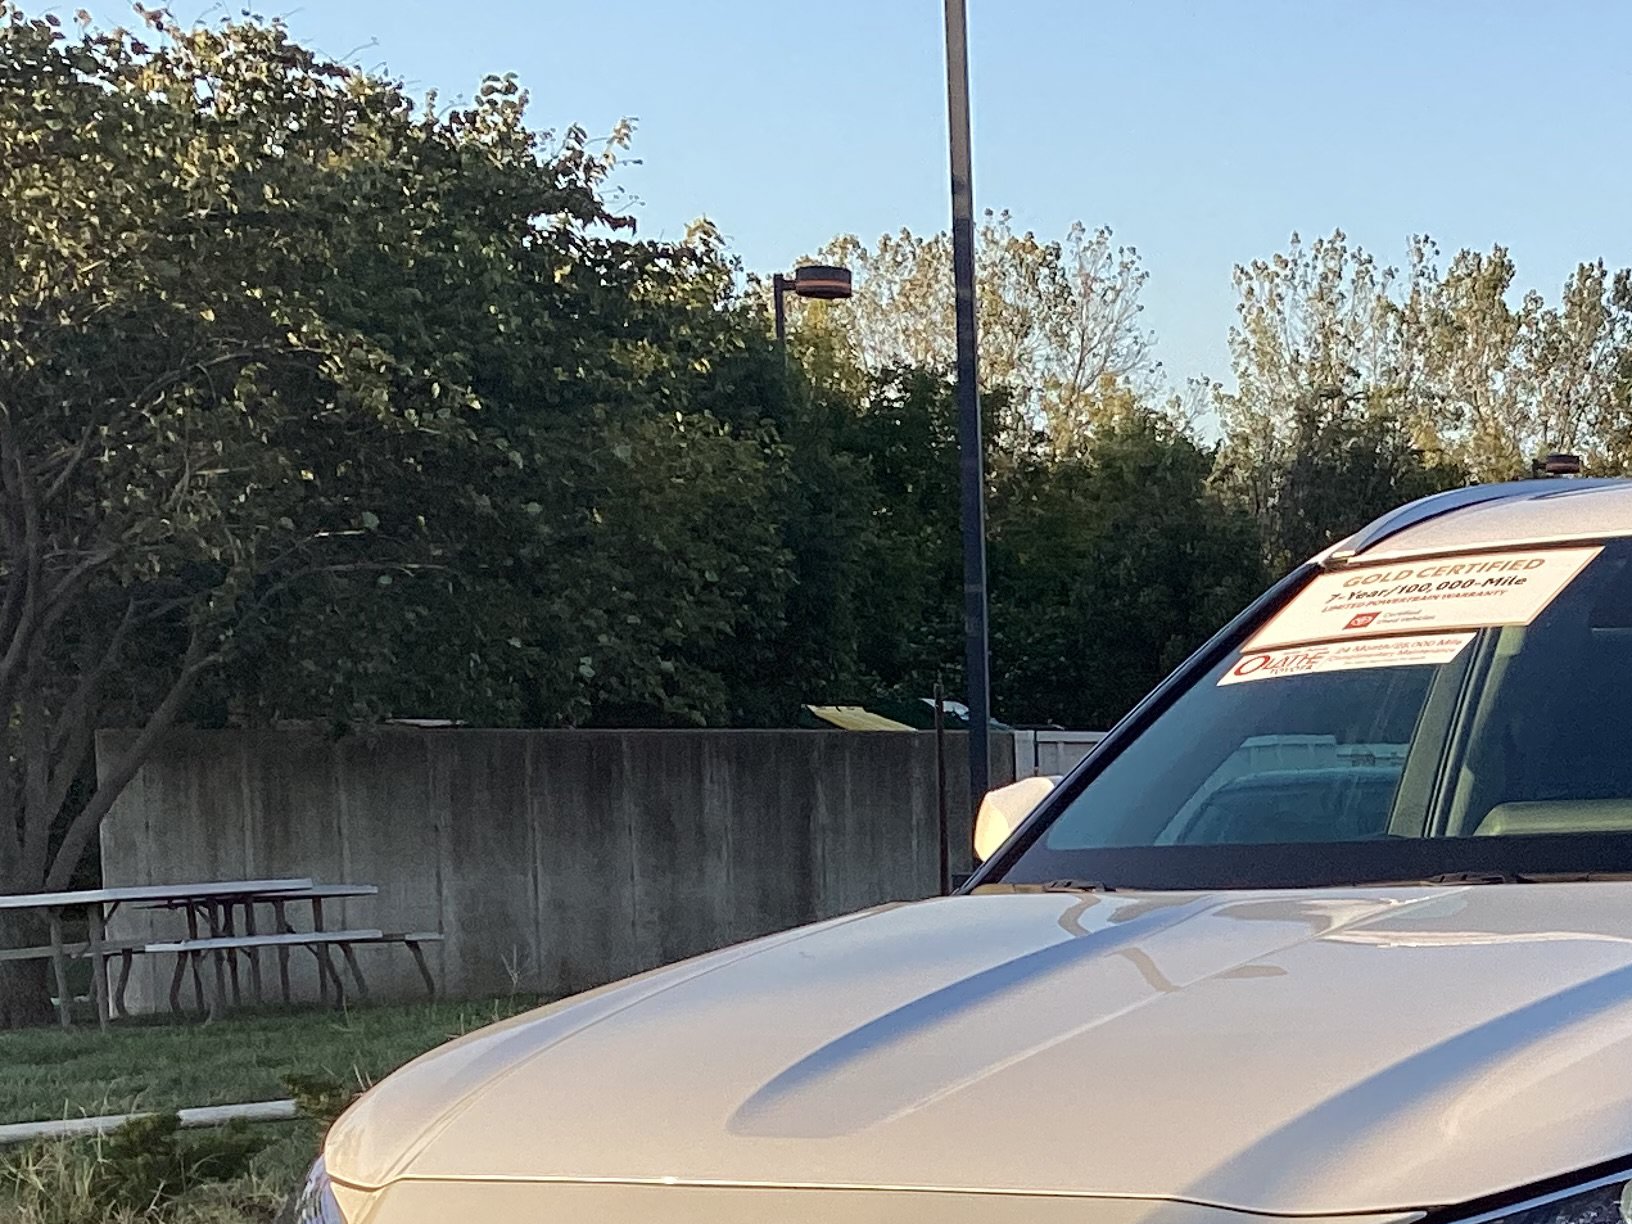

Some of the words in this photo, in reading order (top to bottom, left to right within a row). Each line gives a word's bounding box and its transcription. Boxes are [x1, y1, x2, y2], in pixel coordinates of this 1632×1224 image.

[1343, 569, 1414, 588] GOLD
[1416, 558, 1545, 578] CERTIFIED
[1325, 575, 1528, 604] 7-Year/100,000-Mile
